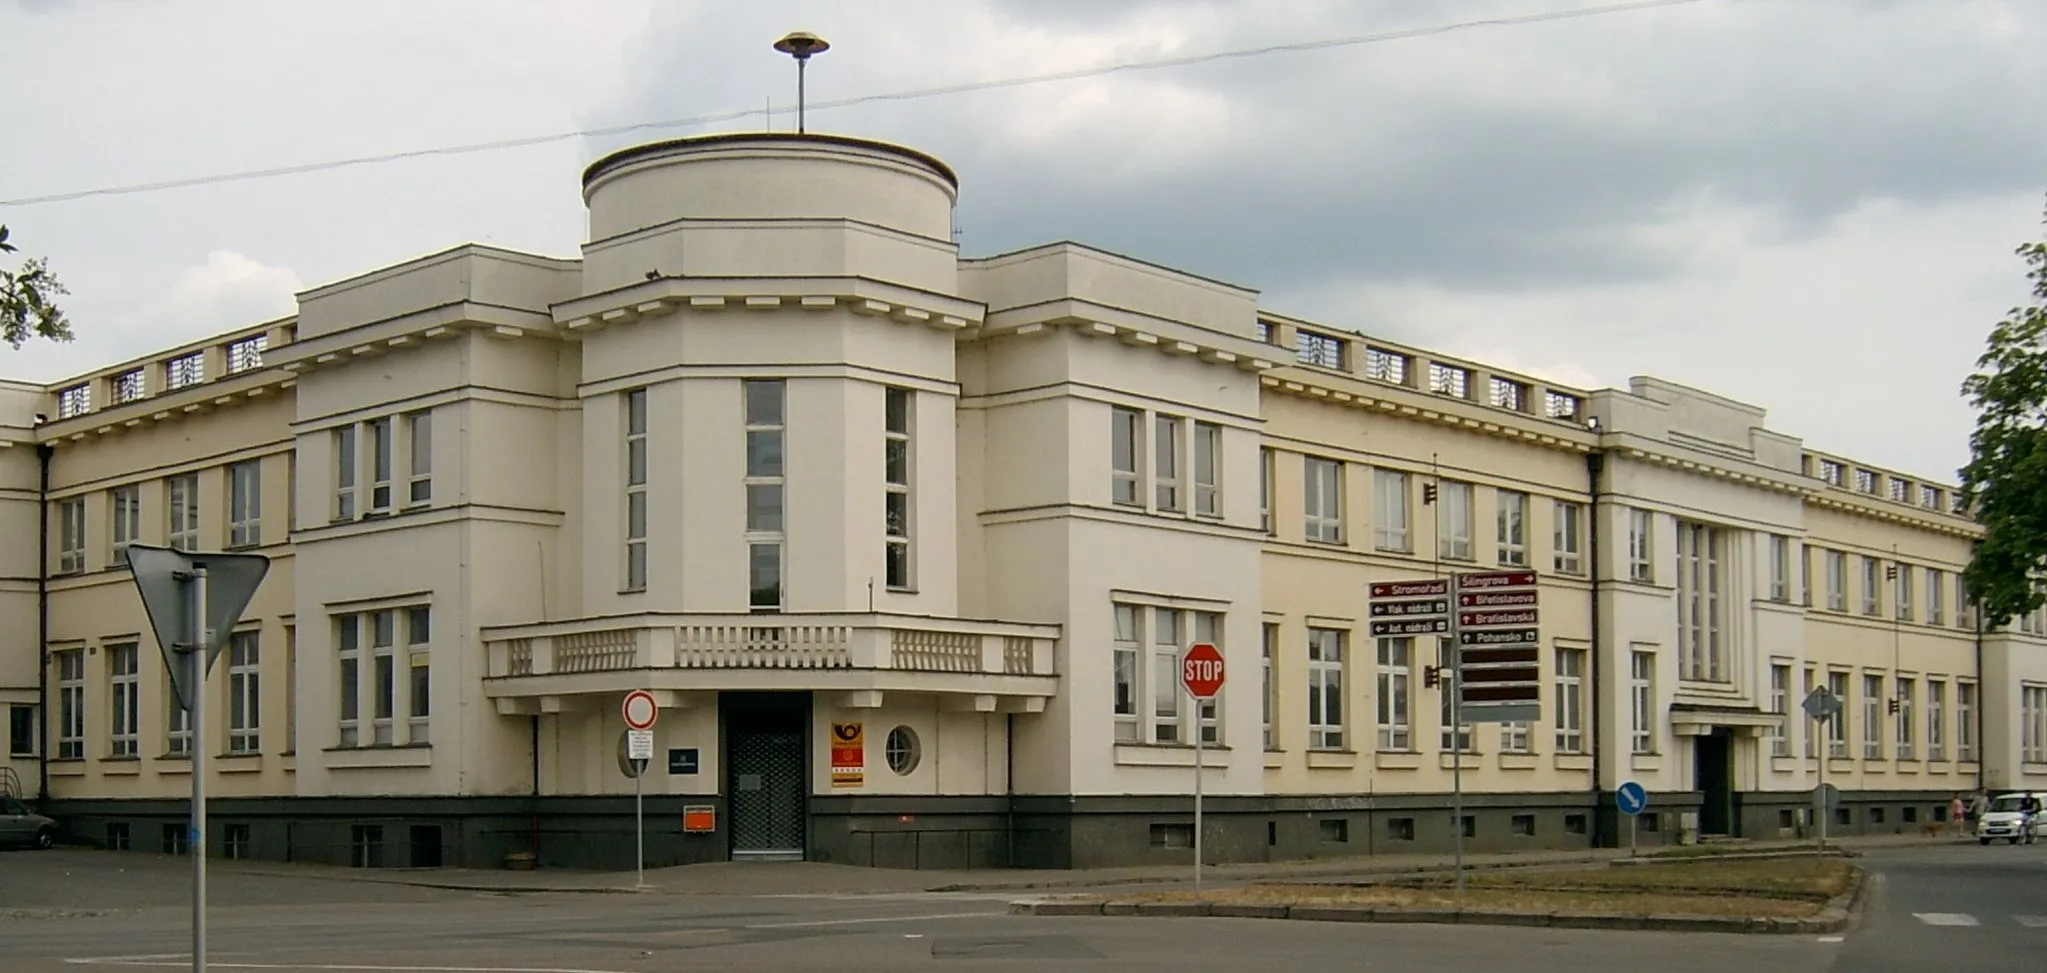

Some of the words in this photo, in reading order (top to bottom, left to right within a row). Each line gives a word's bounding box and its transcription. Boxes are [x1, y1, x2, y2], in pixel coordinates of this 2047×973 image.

[1476, 594, 1534, 605] Břetislavova
[1476, 612, 1535, 624] Bratislavská
[1477, 632, 1521, 642] Pohansko
[1186, 660, 1222, 681] STOP
